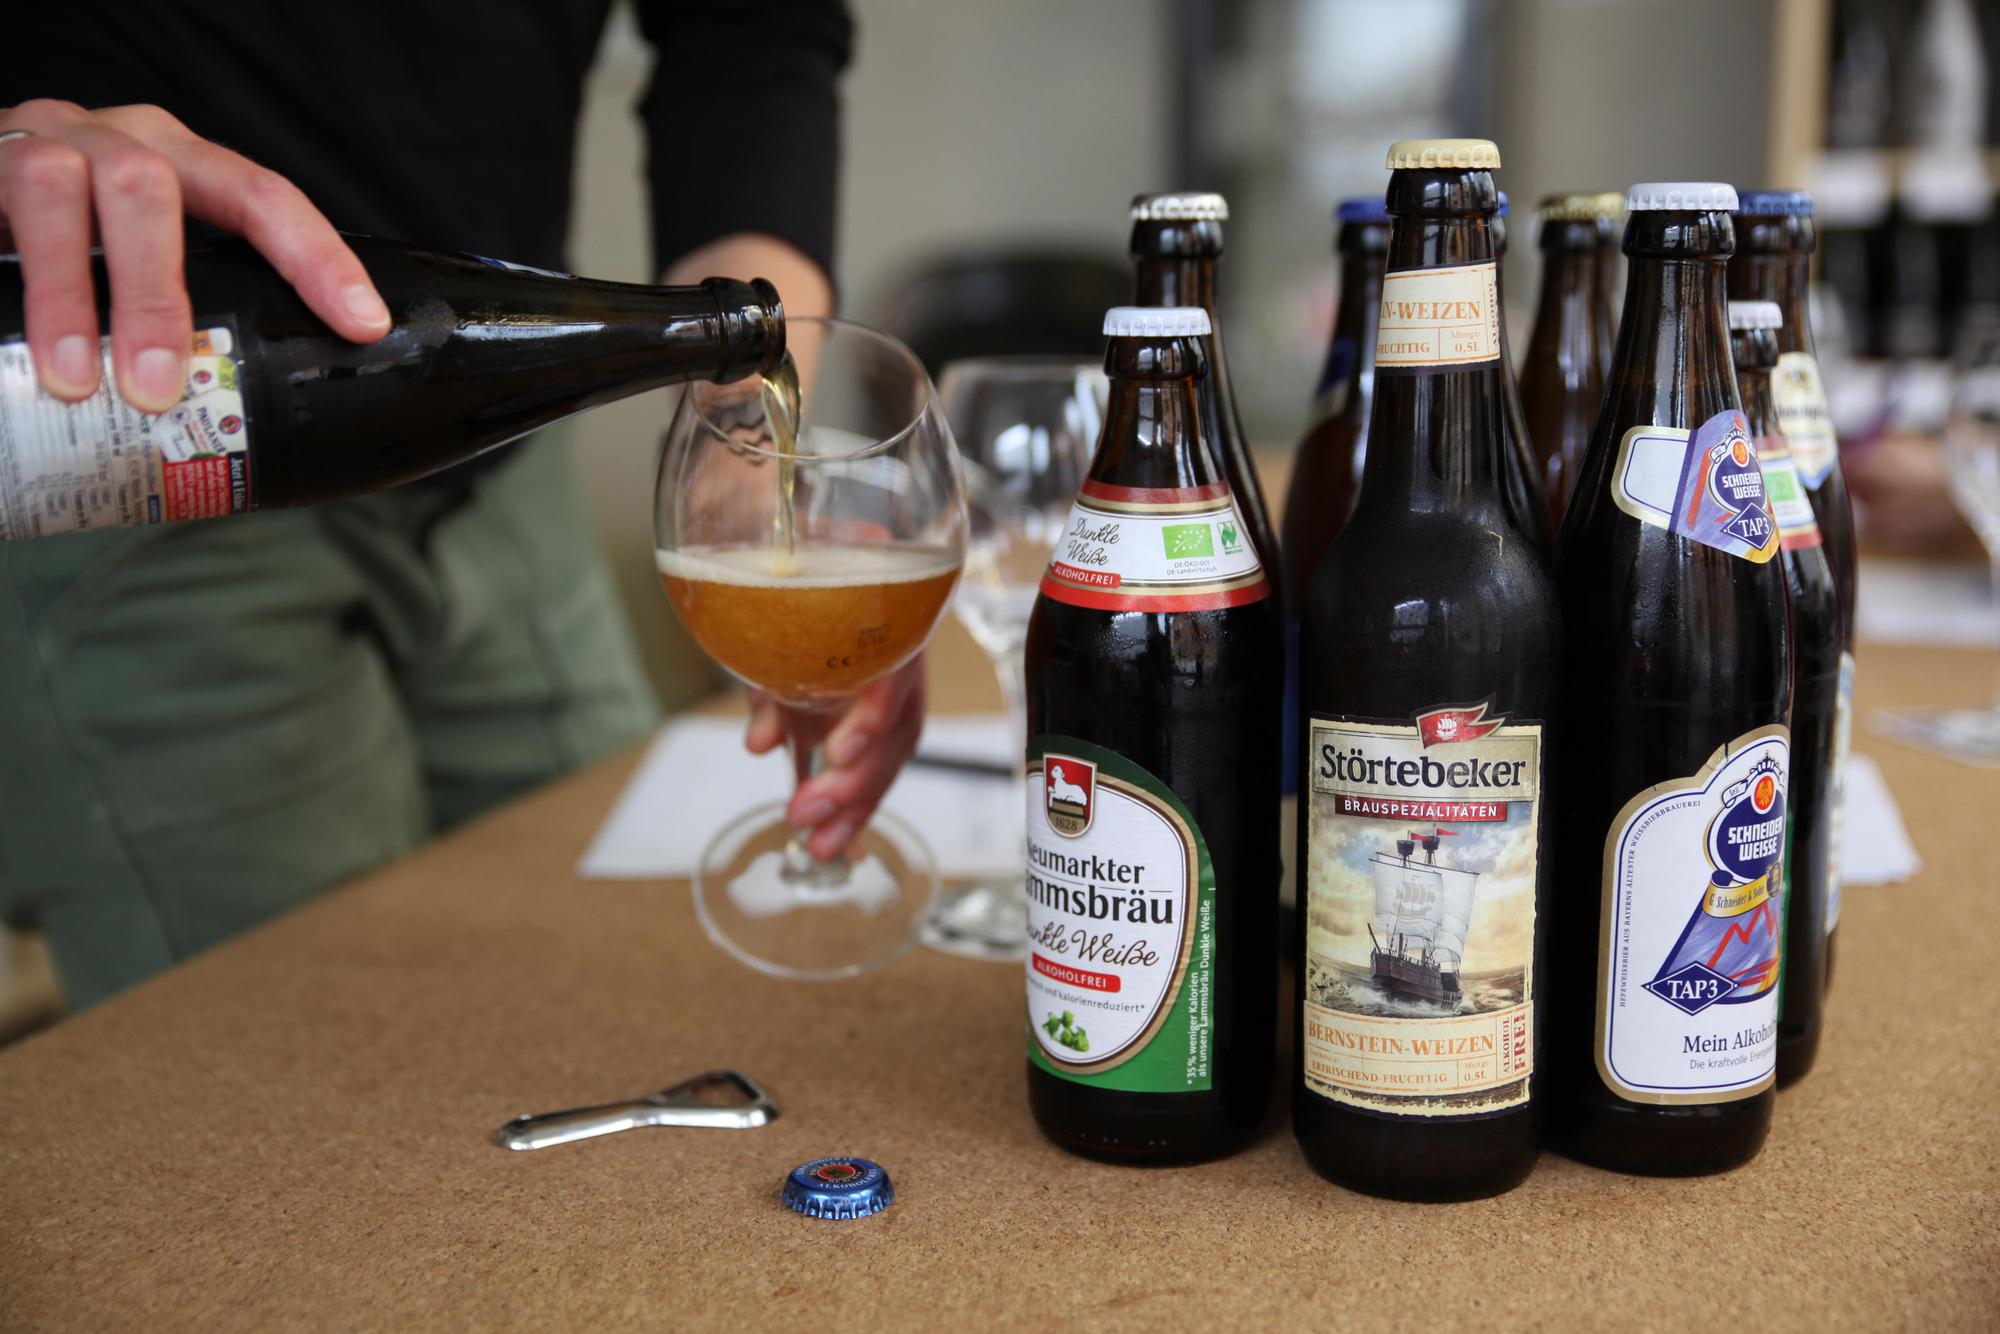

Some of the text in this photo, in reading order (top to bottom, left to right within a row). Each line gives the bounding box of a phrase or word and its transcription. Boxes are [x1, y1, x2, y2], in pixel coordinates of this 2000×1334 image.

[1380, 301, 1481, 320] N-WEIZEN
[1721, 472, 1762, 489] SCHNEIDER
[1732, 484, 1762, 499] WEISSE
[1070, 517, 1120, 545] Dunkle
[1068, 539, 1108, 566] Weiße
[1055, 565, 1114, 585] ALKOHOLFREI
[1320, 744, 1526, 788] Störtebeker
[1344, 799, 1497, 817] BRAUSPEZIALITÄTEN
[1054, 815, 1078, 832] 1628
[1630, 798, 1701, 848] WEISSBIERBRAUEREI
[1728, 816, 1783, 844] SCHNEIDER
[1739, 837, 1777, 861] WEISSE
[1626, 849, 1636, 889] ÄLTESTER
[1624, 890, 1633, 927] BAYERNS
[1716, 891, 1747, 909] Schneider
[1071, 929, 1160, 967] Weiße
[1037, 960, 1107, 989] ALKOHOLFREI
[1619, 948, 1629, 1008] HEFEWEISSBIER
[1189, 972, 1199, 1013] Kalorien
[1198, 900, 1210, 1078] als unsere Lammsbräu Dunkle Weiße
[1189, 1015, 1200, 1054] weniger
[1308, 1022, 1494, 1057] BERNSTEIN-WEIZEN
[1502, 1016, 1510, 1074] ALKOHOL
[1513, 1013, 1526, 1071] FREI
[1682, 1034, 1728, 1054] Mein
[1689, 1059, 1705, 1070] Die
[1708, 1054, 1748, 1069] kraftvolle
[1384, 1072, 1448, 1084] FRUCHTIG
